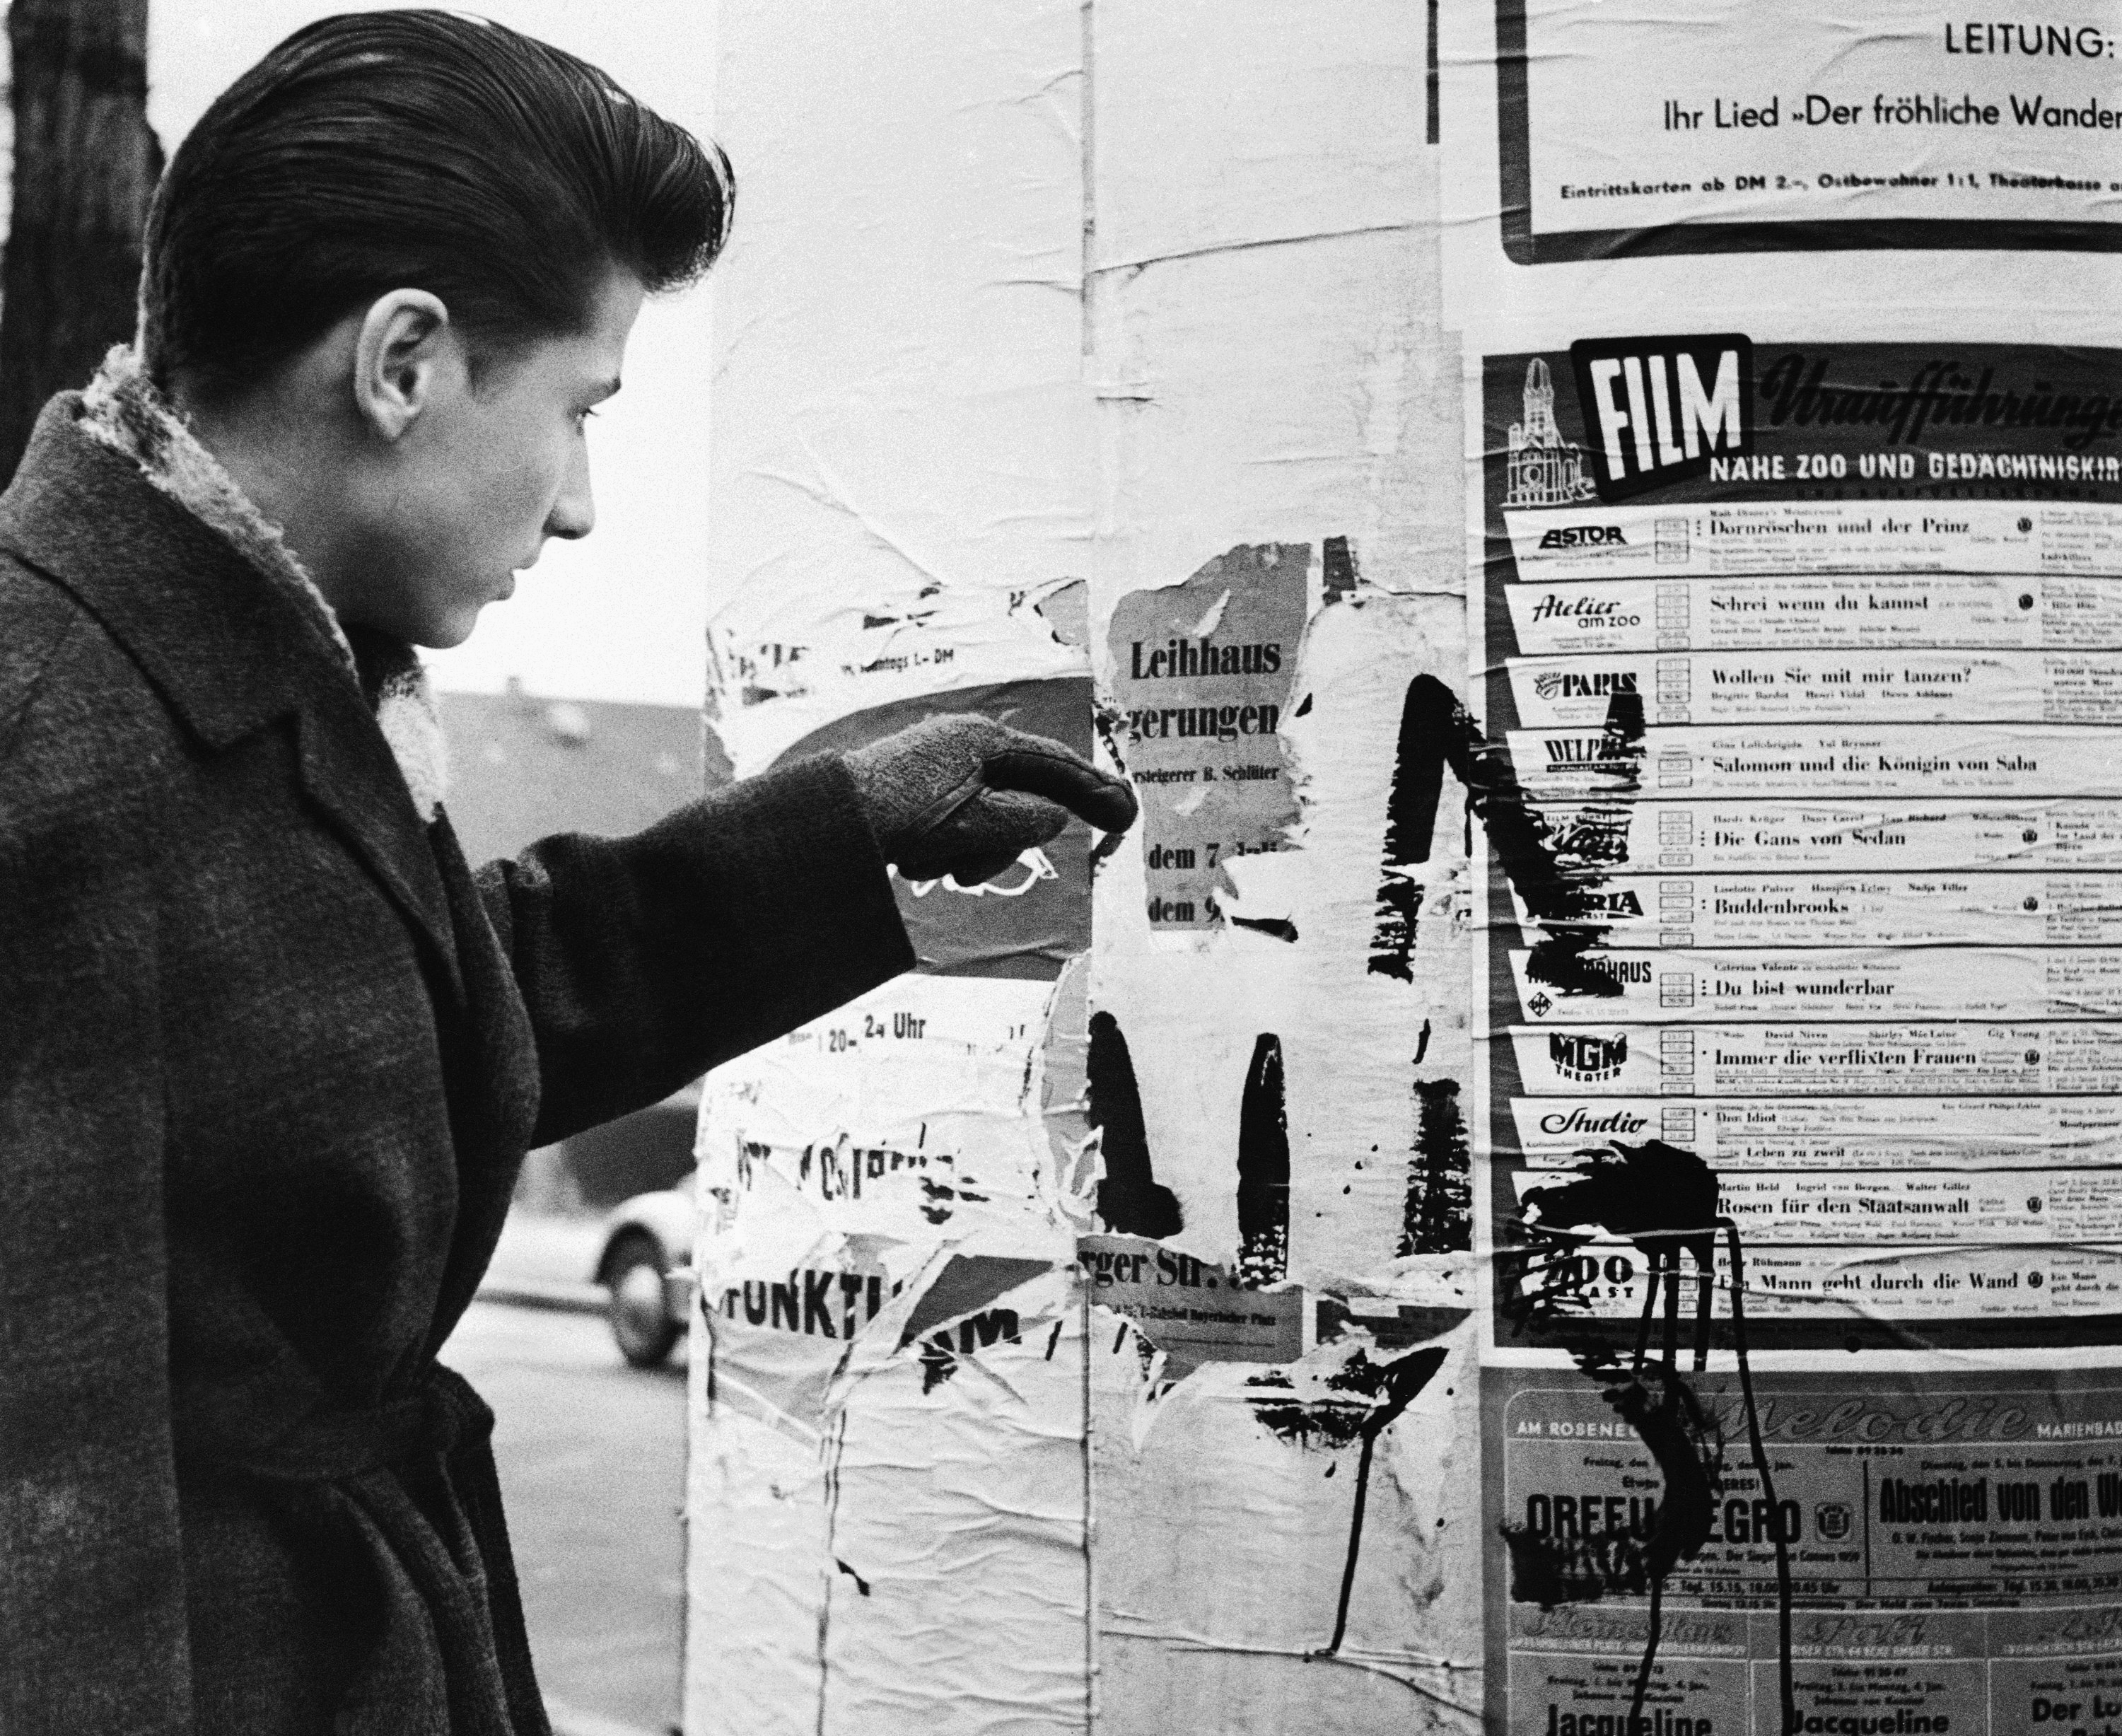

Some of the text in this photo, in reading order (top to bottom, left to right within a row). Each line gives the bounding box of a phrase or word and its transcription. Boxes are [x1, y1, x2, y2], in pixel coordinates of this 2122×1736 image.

[1946, 23, 2114, 57] LEITUNG:
[1665, 101, 1702, 130] Ihr
[1715, 97, 1778, 129] Lied
[1873, 93, 2000, 125] fröhliche
[1561, 180, 1691, 200] Eintrittskarten
[1701, 179, 1726, 194] ab
[1735, 175, 1766, 192] DM
[1818, 171, 1937, 189] Ostbewohner
[1988, 172, 2101, 191] Theaterkasse
[1590, 349, 1742, 482] FILM
[1796, 453, 1847, 479] ZOO
[1858, 453, 1915, 479] UND
[1539, 525, 1628, 550] ASTOR
[1710, 517, 1970, 535] Dornröschen und der Prinz
[1532, 593, 1621, 623] Atelier
[1710, 594, 1929, 612] Schrei wenn du kannst
[1578, 615, 1605, 629] am
[933, 648, 954, 665] DM
[1131, 637, 1282, 680] Leihhaus
[1563, 672, 1637, 697] PARIS
[1711, 667, 1972, 685] Wollen Sie mit mir tanzen?
[1127, 703, 1281, 745] gerungen
[1713, 755, 2037, 775] Salomon und die Königin von Saba
[1714, 829, 1906, 846] Die Gans von Sedan
[1148, 843, 1195, 870] dem
[1147, 895, 1195, 923] dem
[1714, 897, 1849, 915] Buddenbrooks
[1716, 978, 1895, 996] Du bist wunderbar
[893, 1012, 926, 1039] Uhr
[1765, 1030, 1794, 1039] David
[1549, 1032, 1627, 1073] MGM
[1715, 1048, 1976, 1066] Immer die verflixten Frauen
[1553, 1063, 1622, 1083] THEATER
[1539, 1106, 1648, 1134] Studio
[1747, 1112, 1777, 1123] Idiot
[1747, 1147, 1846, 1158] Leben zu zweit
[1756, 1182, 1780, 1192] Held
[1795, 1182, 1826, 1194] Ingrid
[1906, 1182, 1937, 1192] Walter
[1718, 1197, 1970, 1214] Rosen für den Staatsanwalt
[1761, 1271, 2018, 1294] Mann geht durch die Wand
[1517, 1421, 1542, 1435] AM
[1879, 1476, 1988, 1524] Abschied
[1996, 1482, 2041, 1522] von
[2050, 1475, 2089, 1521] den
[1526, 1493, 1655, 1542] ORFEU
[2031, 1697, 2082, 1723] Der
